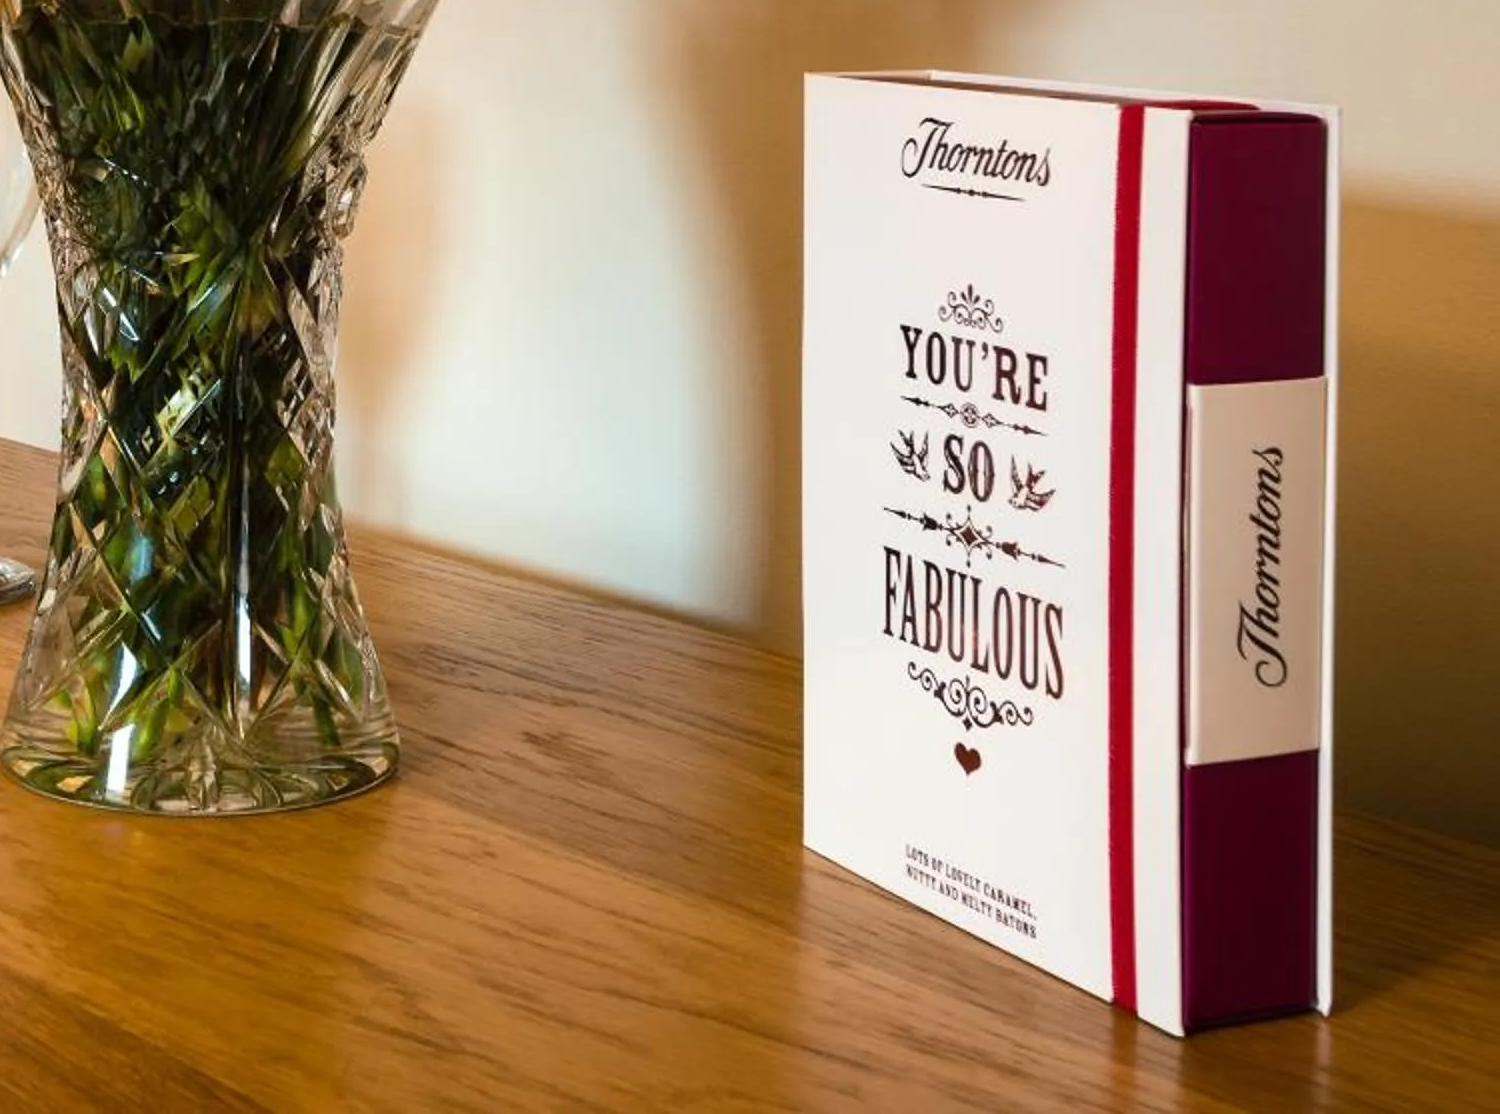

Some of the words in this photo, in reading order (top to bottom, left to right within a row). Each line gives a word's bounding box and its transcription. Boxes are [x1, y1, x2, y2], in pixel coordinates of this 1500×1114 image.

[900, 116, 1051, 187] Thorntons
[899, 323, 1049, 412] YOU'RE
[943, 433, 995, 503] SO
[1236, 446, 1288, 688] Thorntons
[883, 545, 1065, 700] FABULOUS
[905, 843, 929, 867] LOTS
[931, 857, 943, 873] OF
[945, 863, 981, 893] LOVELY
[905, 863, 937, 891] NUTTY
[938, 881, 959, 902] AND
[961, 890, 993, 919] MELTY
[995, 907, 1037, 939] BATONS
